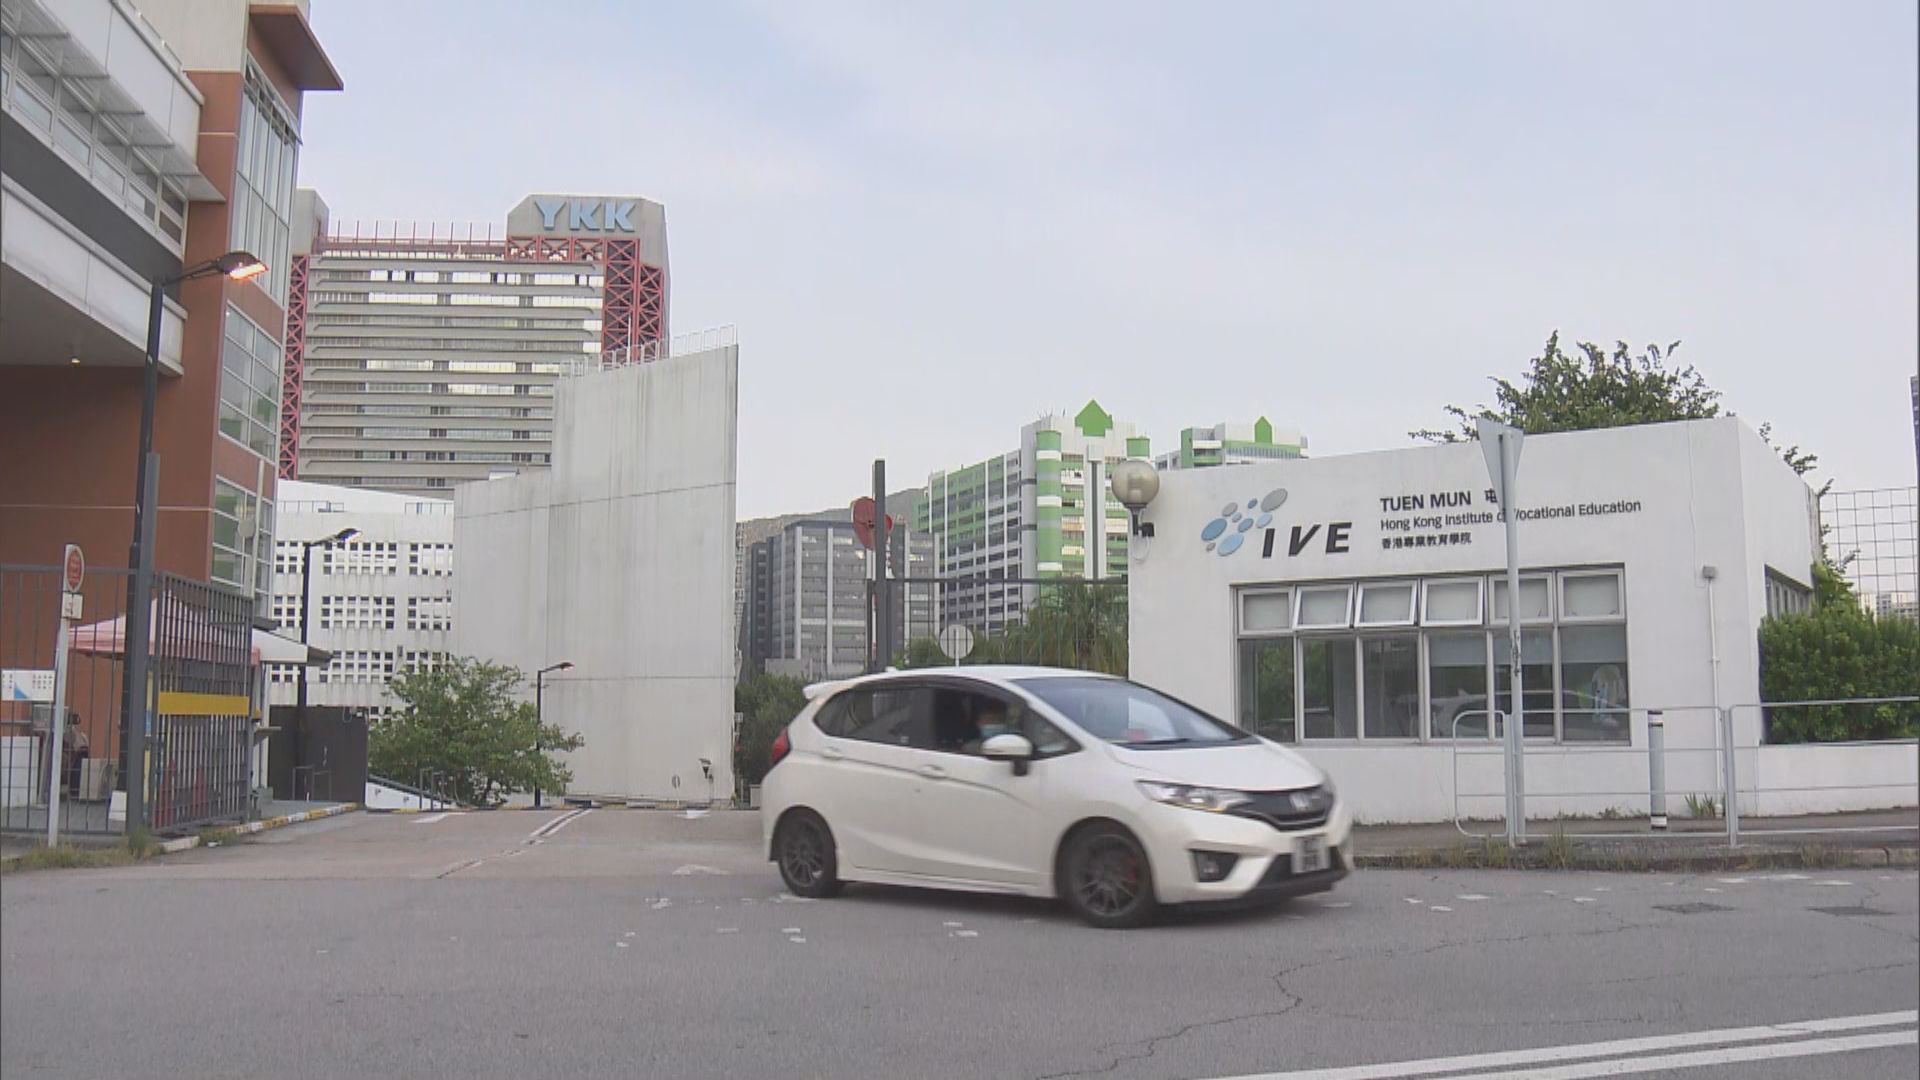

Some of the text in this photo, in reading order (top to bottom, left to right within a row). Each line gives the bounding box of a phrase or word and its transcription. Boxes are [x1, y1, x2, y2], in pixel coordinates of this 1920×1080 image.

[534, 198, 636, 232] YKK
[1380, 494, 1424, 513] TUEN
[1430, 490, 1472, 509] MUN
[1380, 518, 1410, 533] Hong
[1413, 515, 1442, 530] Kong
[1445, 512, 1493, 526] Institute
[1578, 499, 1641, 516] Education
[1261, 522, 1353, 559] IVE
